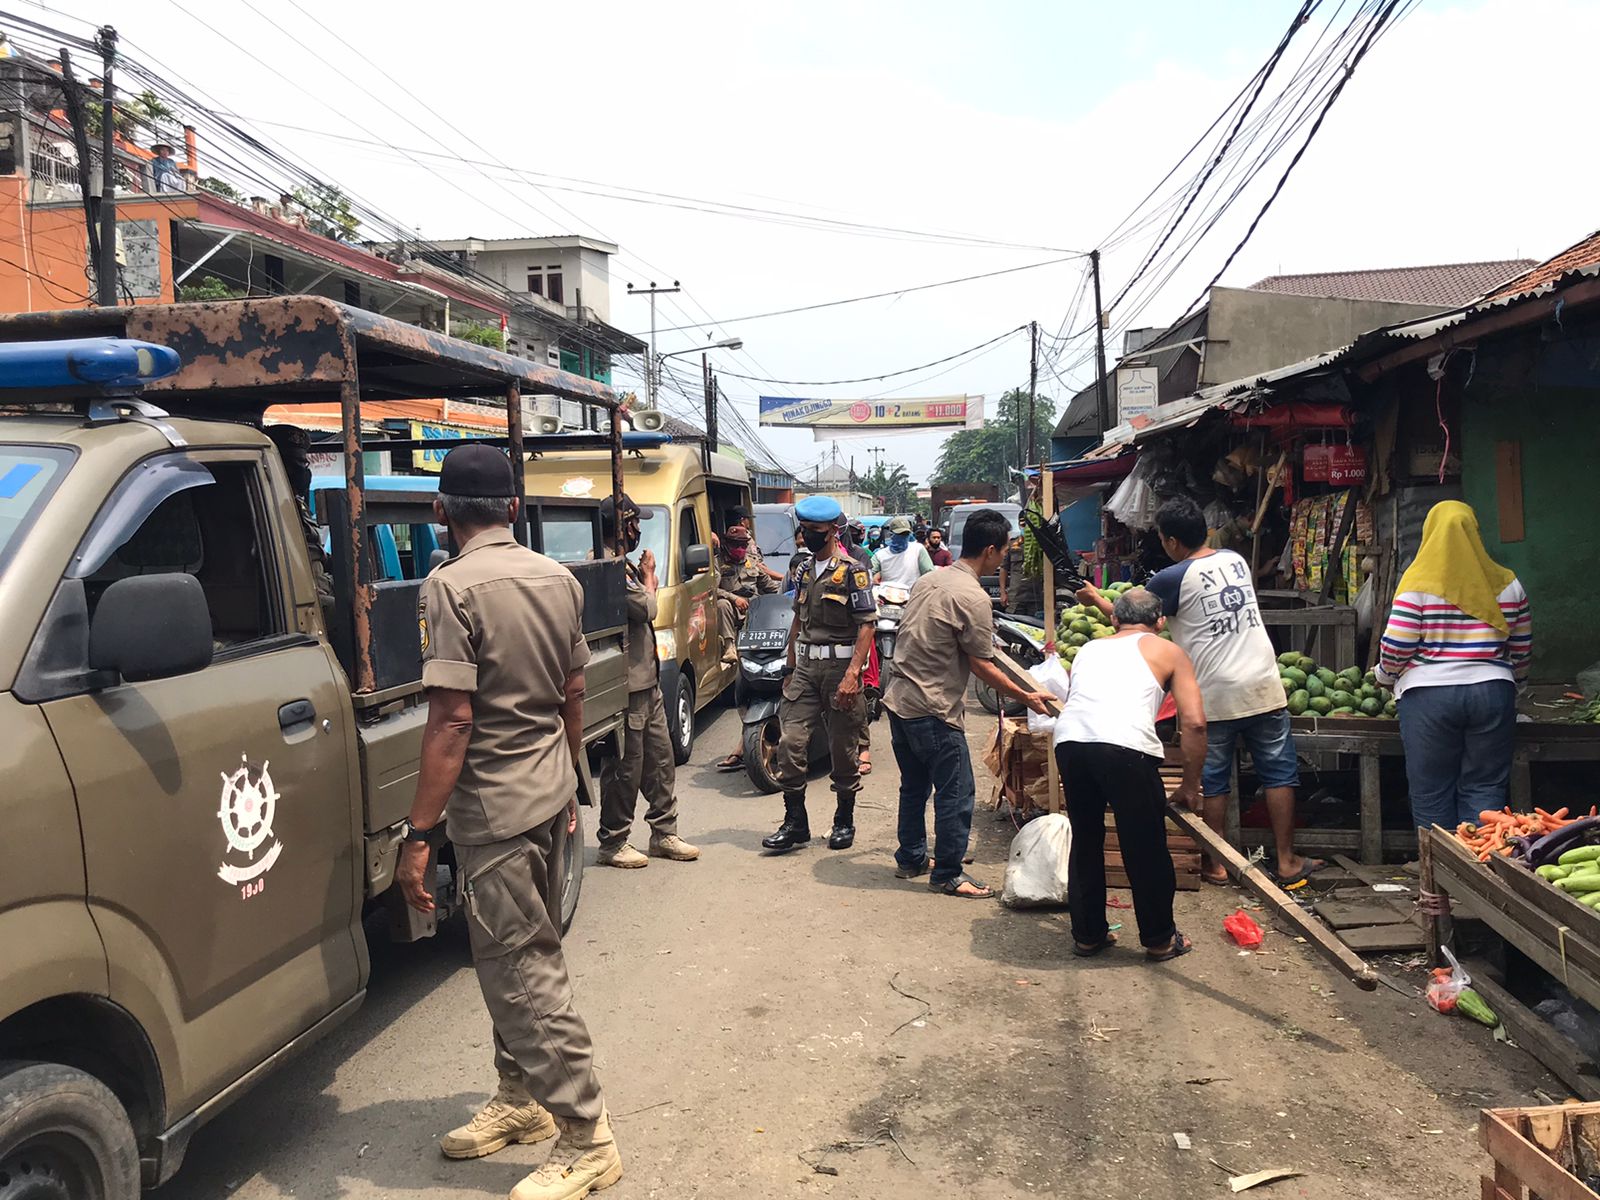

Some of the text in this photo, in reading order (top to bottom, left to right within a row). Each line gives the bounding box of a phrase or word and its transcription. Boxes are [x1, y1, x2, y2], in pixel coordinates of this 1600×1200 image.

[875, 405, 885, 417] 10
[894, 405, 901, 417] 2
[1331, 469, 1365, 480] Rp 1.000
[749, 632, 767, 640] 2123
